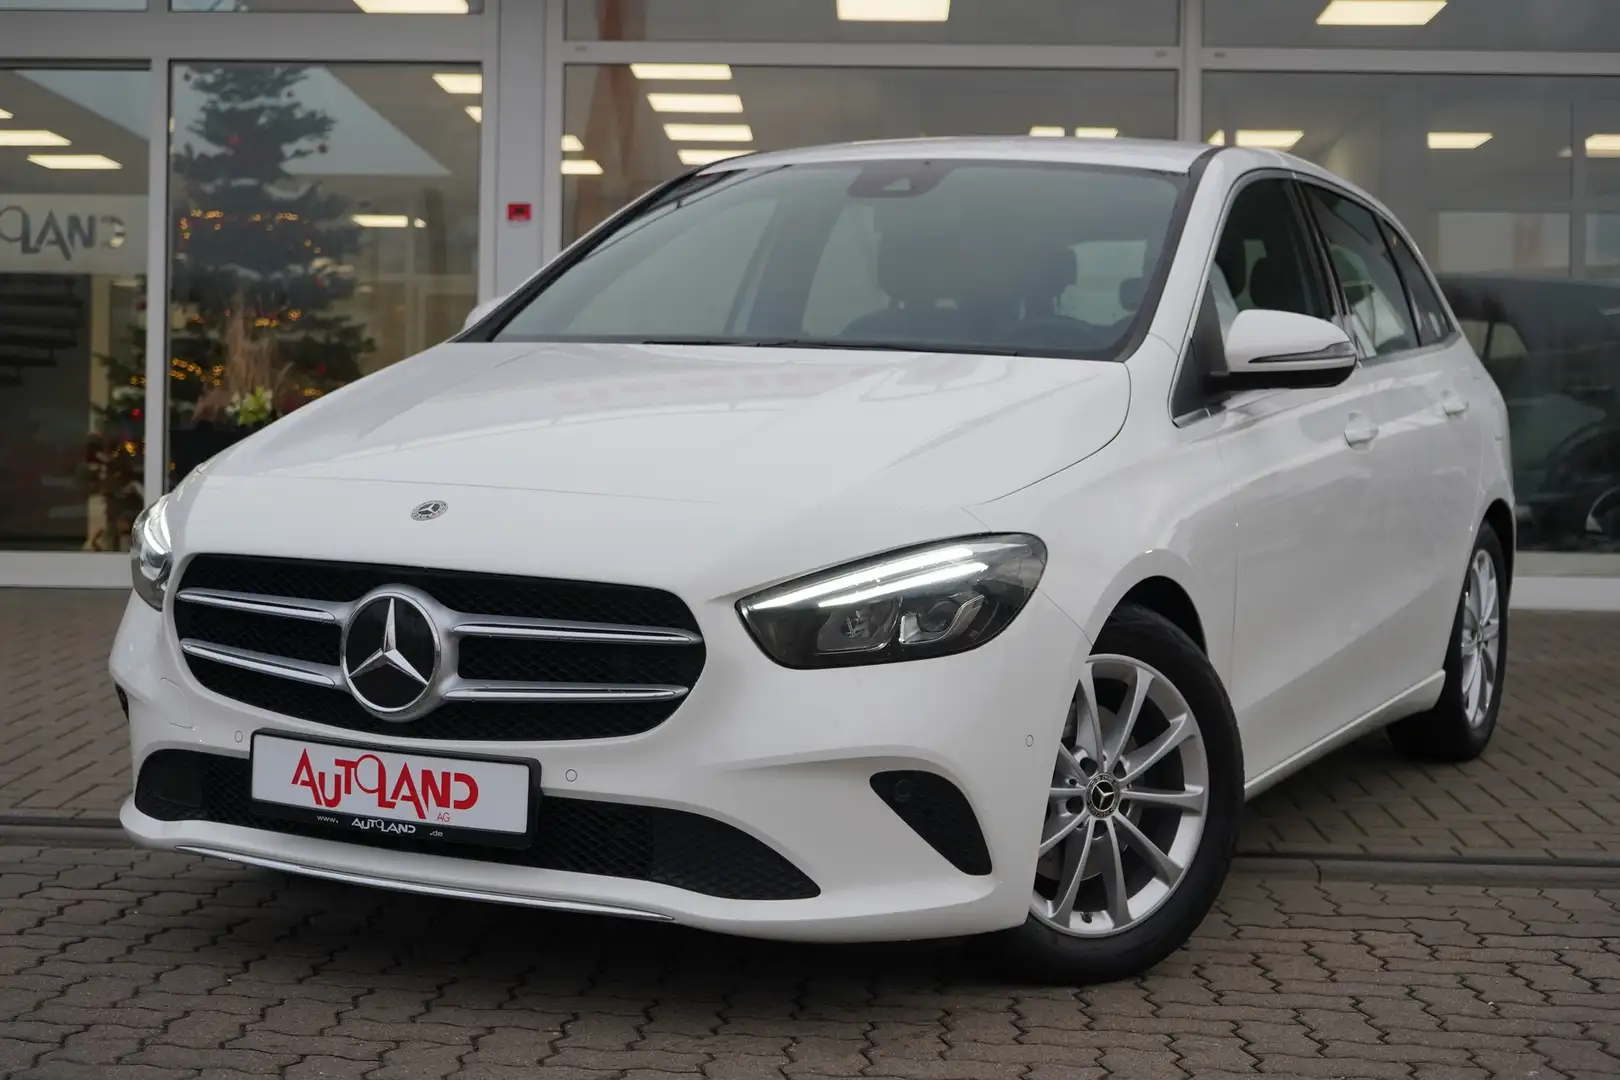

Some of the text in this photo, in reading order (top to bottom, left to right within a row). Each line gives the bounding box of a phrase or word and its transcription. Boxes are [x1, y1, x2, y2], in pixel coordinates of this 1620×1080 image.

[291, 748, 479, 819] AUTOLAND
[316, 814, 444, 837] www. AUTOLAND .de
[436, 812, 451, 823] AG
